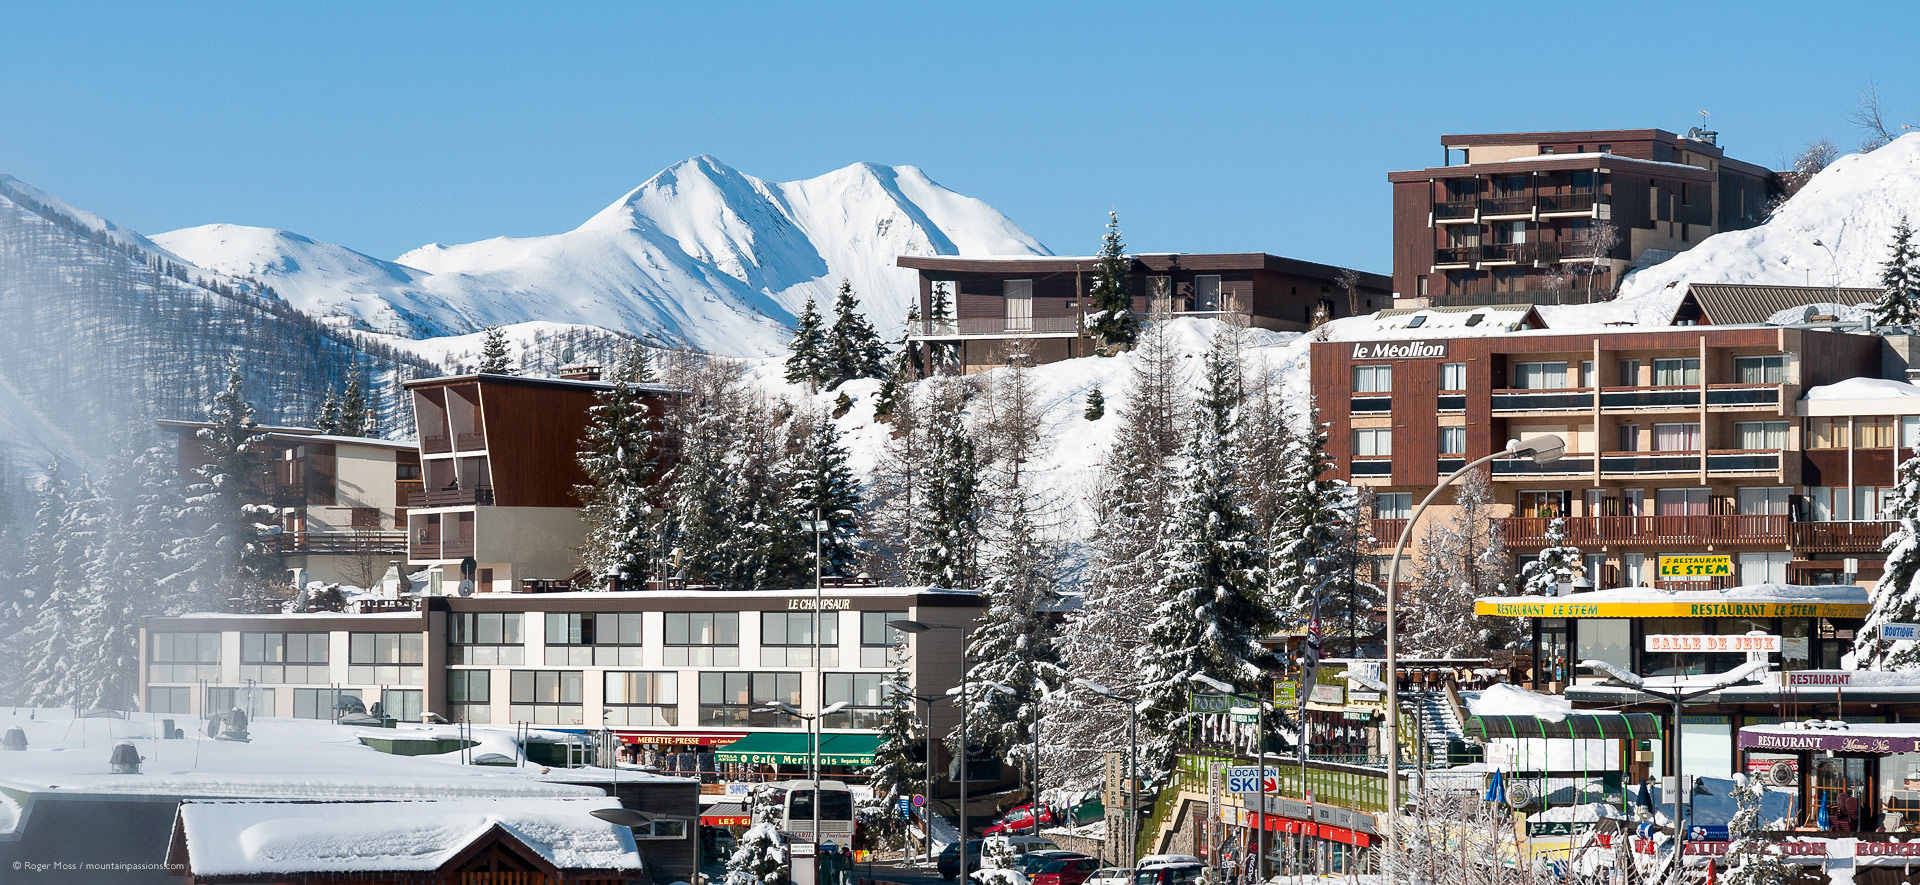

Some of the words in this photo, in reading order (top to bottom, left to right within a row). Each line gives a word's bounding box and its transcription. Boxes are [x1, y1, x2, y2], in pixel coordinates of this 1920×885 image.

[1352, 343, 1368, 358] le
[1371, 341, 1445, 358] Méollion
[1662, 565, 1683, 575] LE
[1686, 564, 1729, 575] STEM
[787, 599, 799, 610] LE
[1496, 603, 1545, 615] RESTAURANT
[1553, 604, 1566, 615] LE
[1568, 604, 1598, 615] STEM
[1691, 603, 1767, 616] RESTAURANT
[1774, 605, 1787, 616] LE
[1790, 604, 1817, 616] STEM
[1884, 626, 1914, 638] BOUTIQUE
[1652, 637, 1702, 650] SALLE
[1707, 637, 1728, 650] DE
[1733, 637, 1775, 650] JEUX
[1790, 674, 1850, 685] RESTAURANT
[1680, 716, 1723, 724] HAUSSURES
[637, 737, 700, 745] MERLETTE-PRESSE
[1758, 735, 1823, 749] RESTAURANT
[1841, 737, 1869, 750] Mamie
[752, 754, 776, 764] Café
[1229, 777, 1260, 793] SKI
